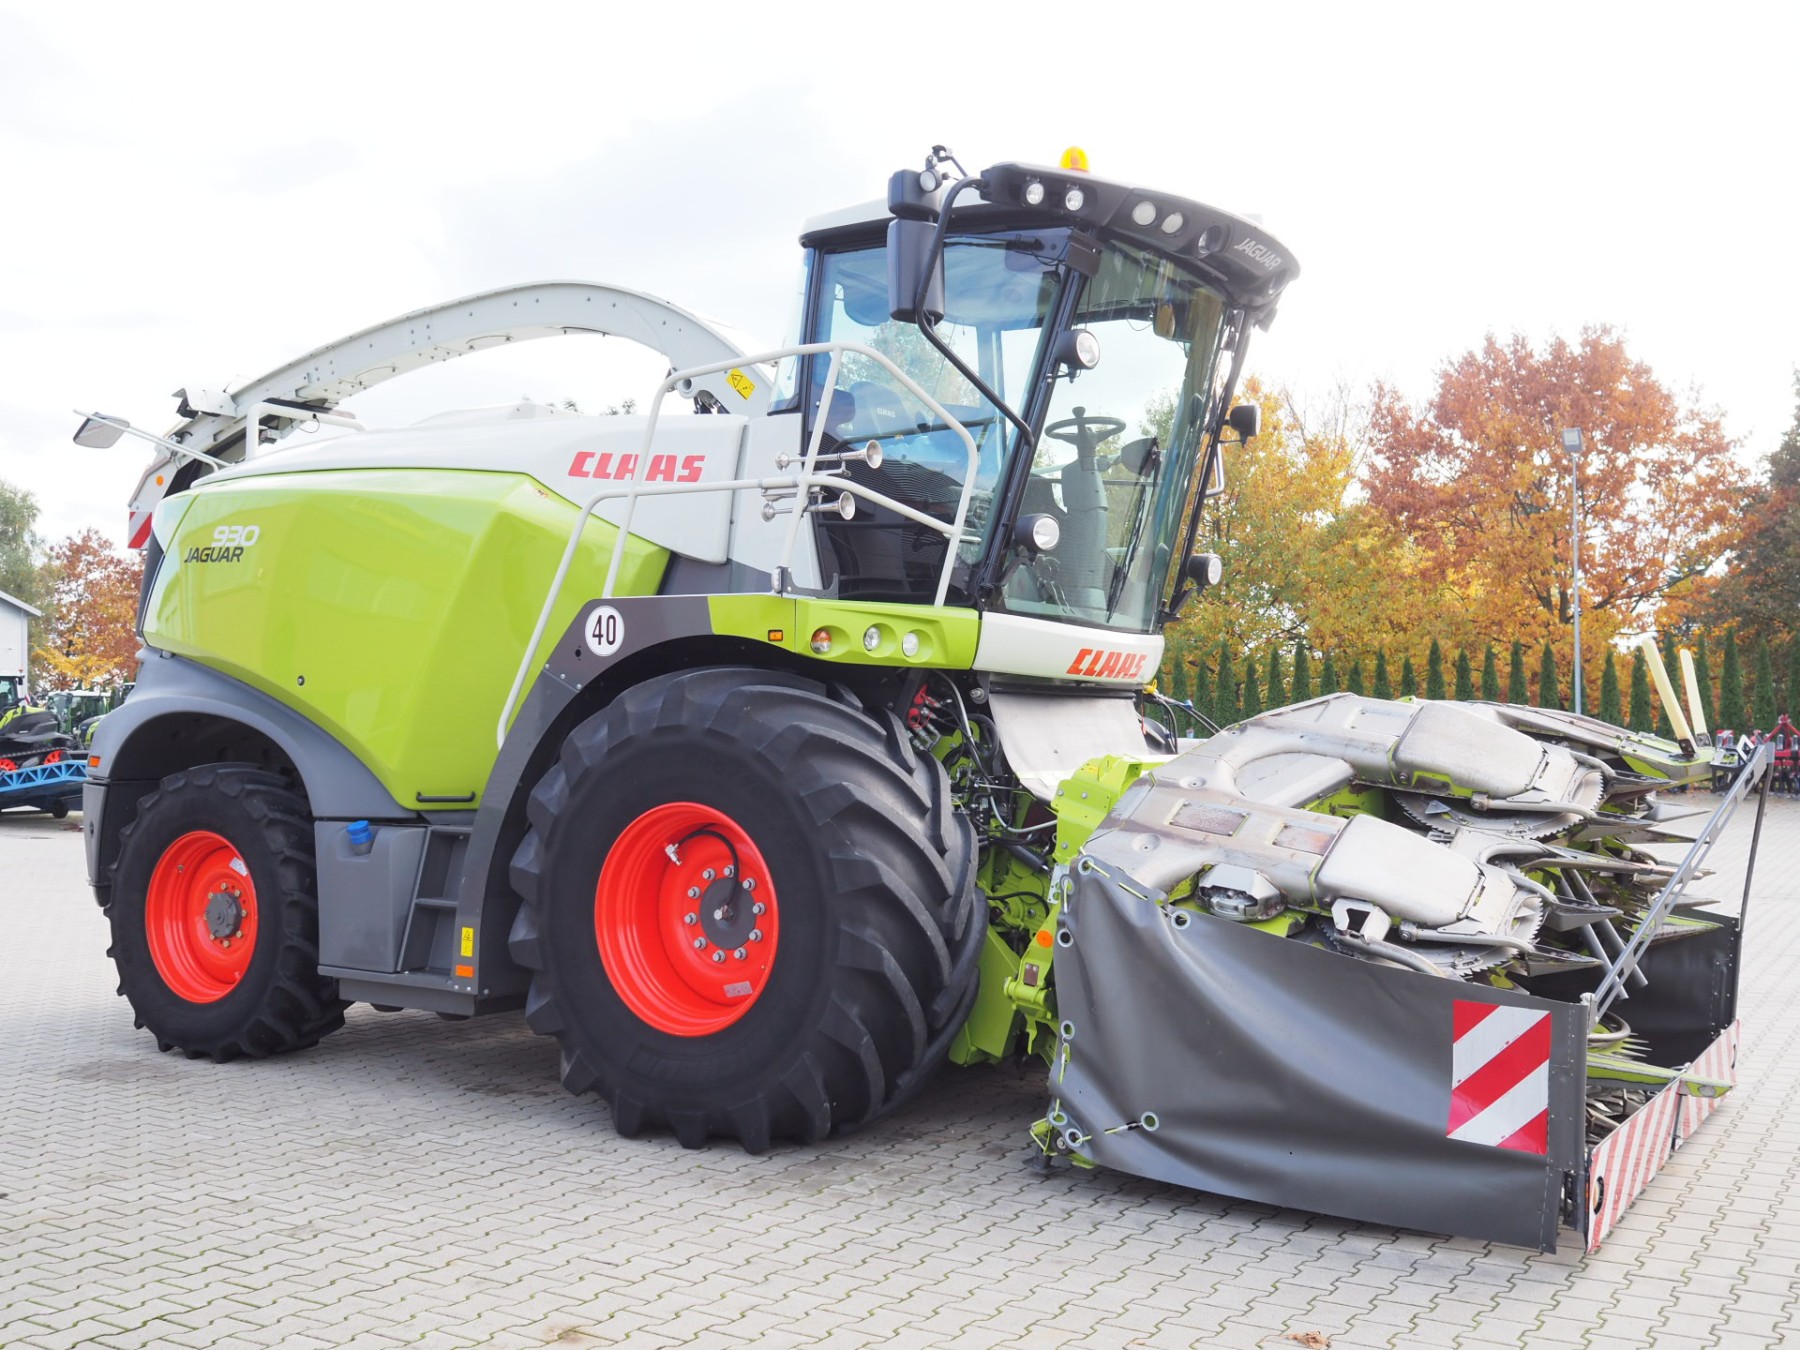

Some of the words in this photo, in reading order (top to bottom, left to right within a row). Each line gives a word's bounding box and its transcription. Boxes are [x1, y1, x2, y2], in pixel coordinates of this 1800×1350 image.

[1233, 237, 1282, 270] JAGUAR
[568, 451, 706, 482] CLAAS
[211, 525, 260, 547] 930
[184, 546, 244, 563] JAGUAR
[592, 614, 617, 646] 40
[1066, 648, 1147, 679] CLAAS
